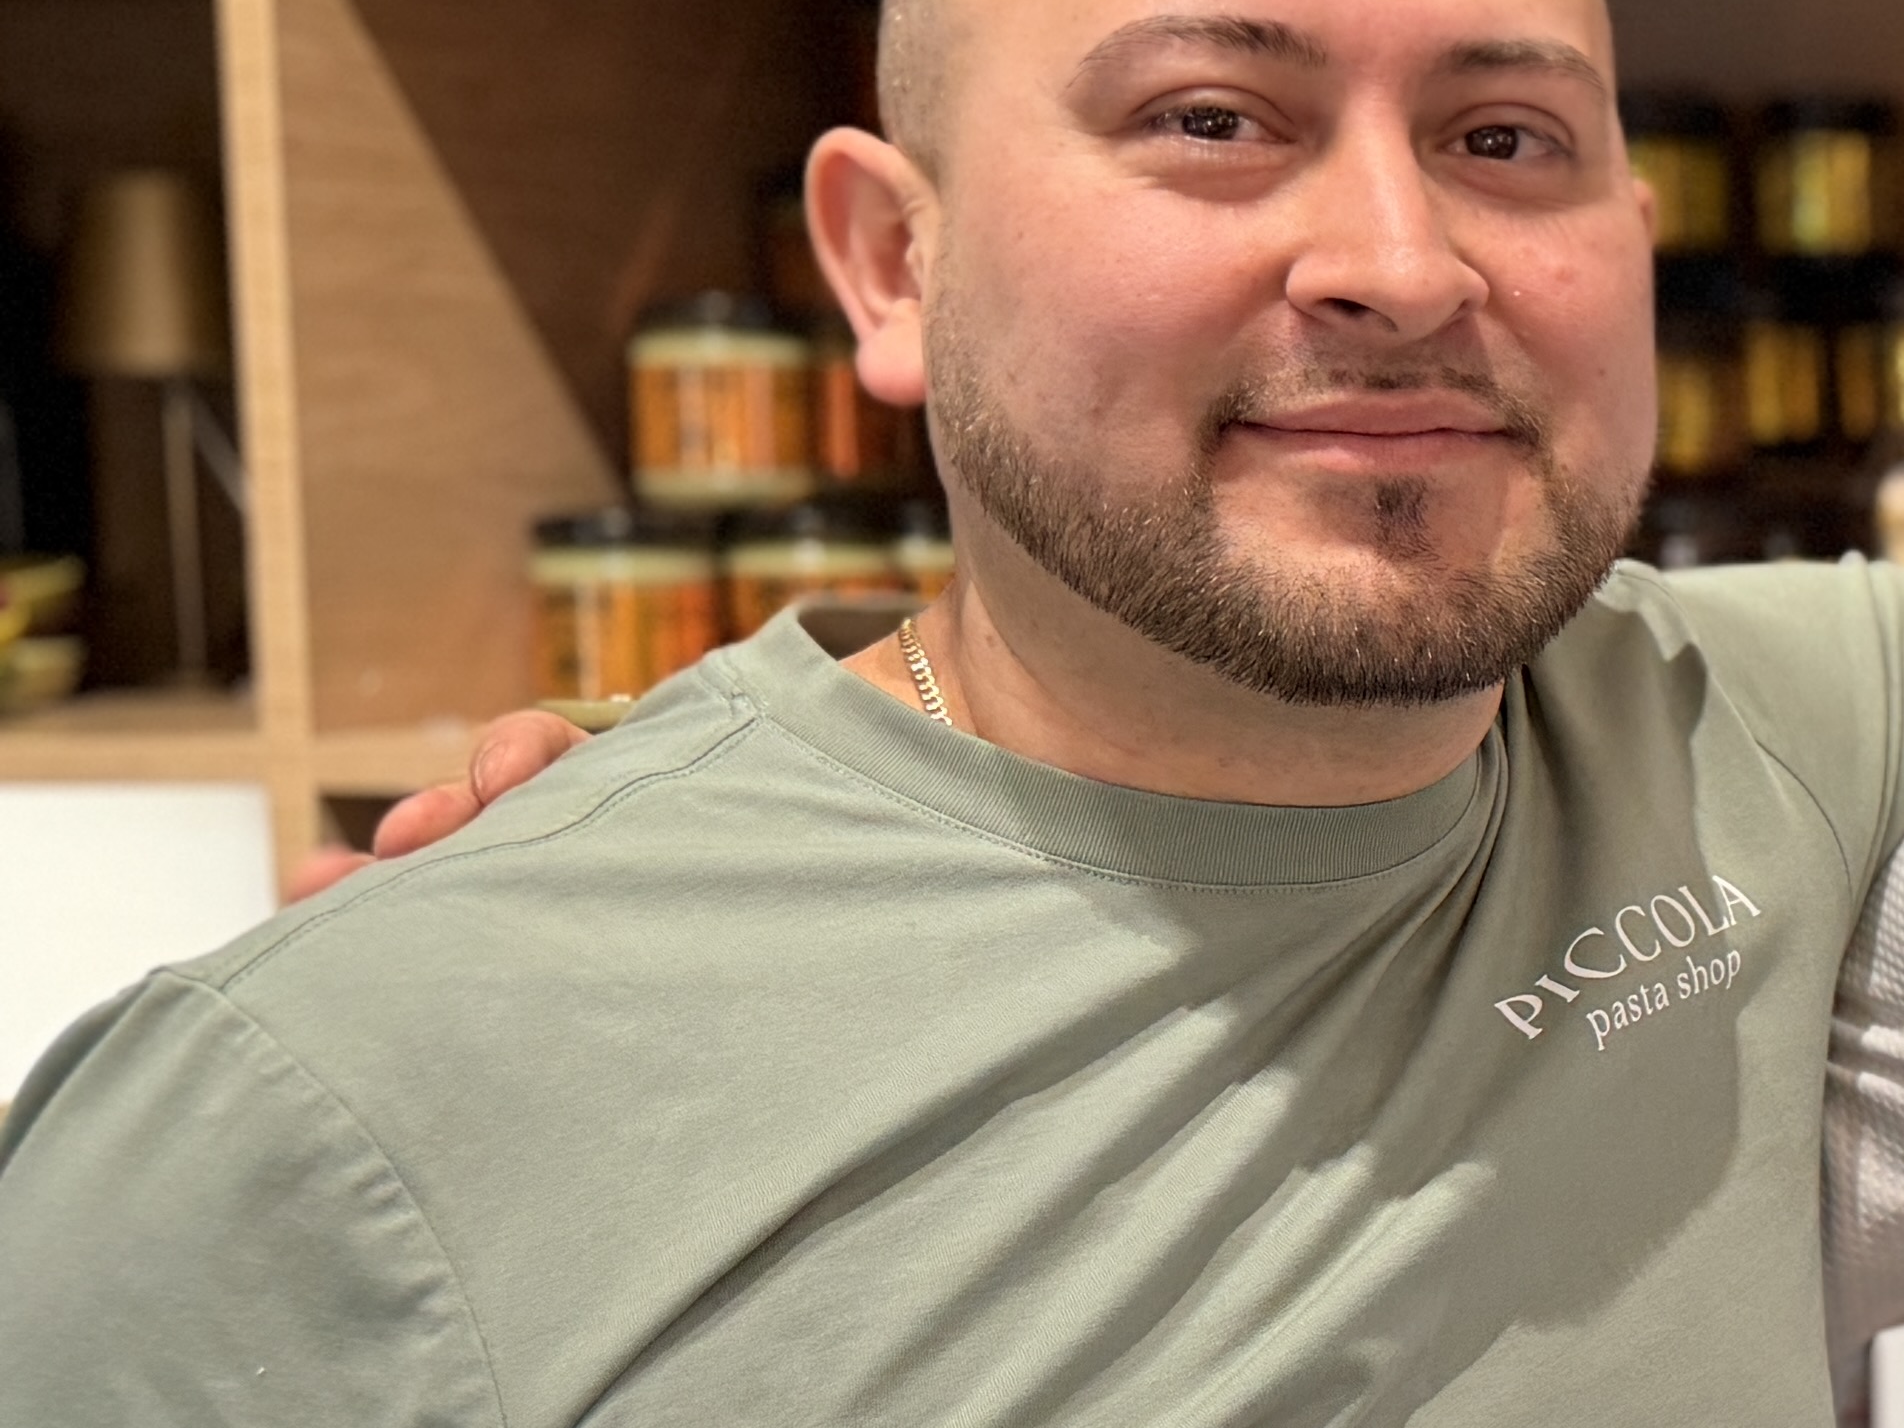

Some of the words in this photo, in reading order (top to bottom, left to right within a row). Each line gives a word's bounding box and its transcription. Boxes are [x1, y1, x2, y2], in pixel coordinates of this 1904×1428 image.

[1493, 874, 1762, 1040] PICCOLA
[1585, 980, 1670, 1051] pasta
[1677, 948, 1742, 1000] shop
